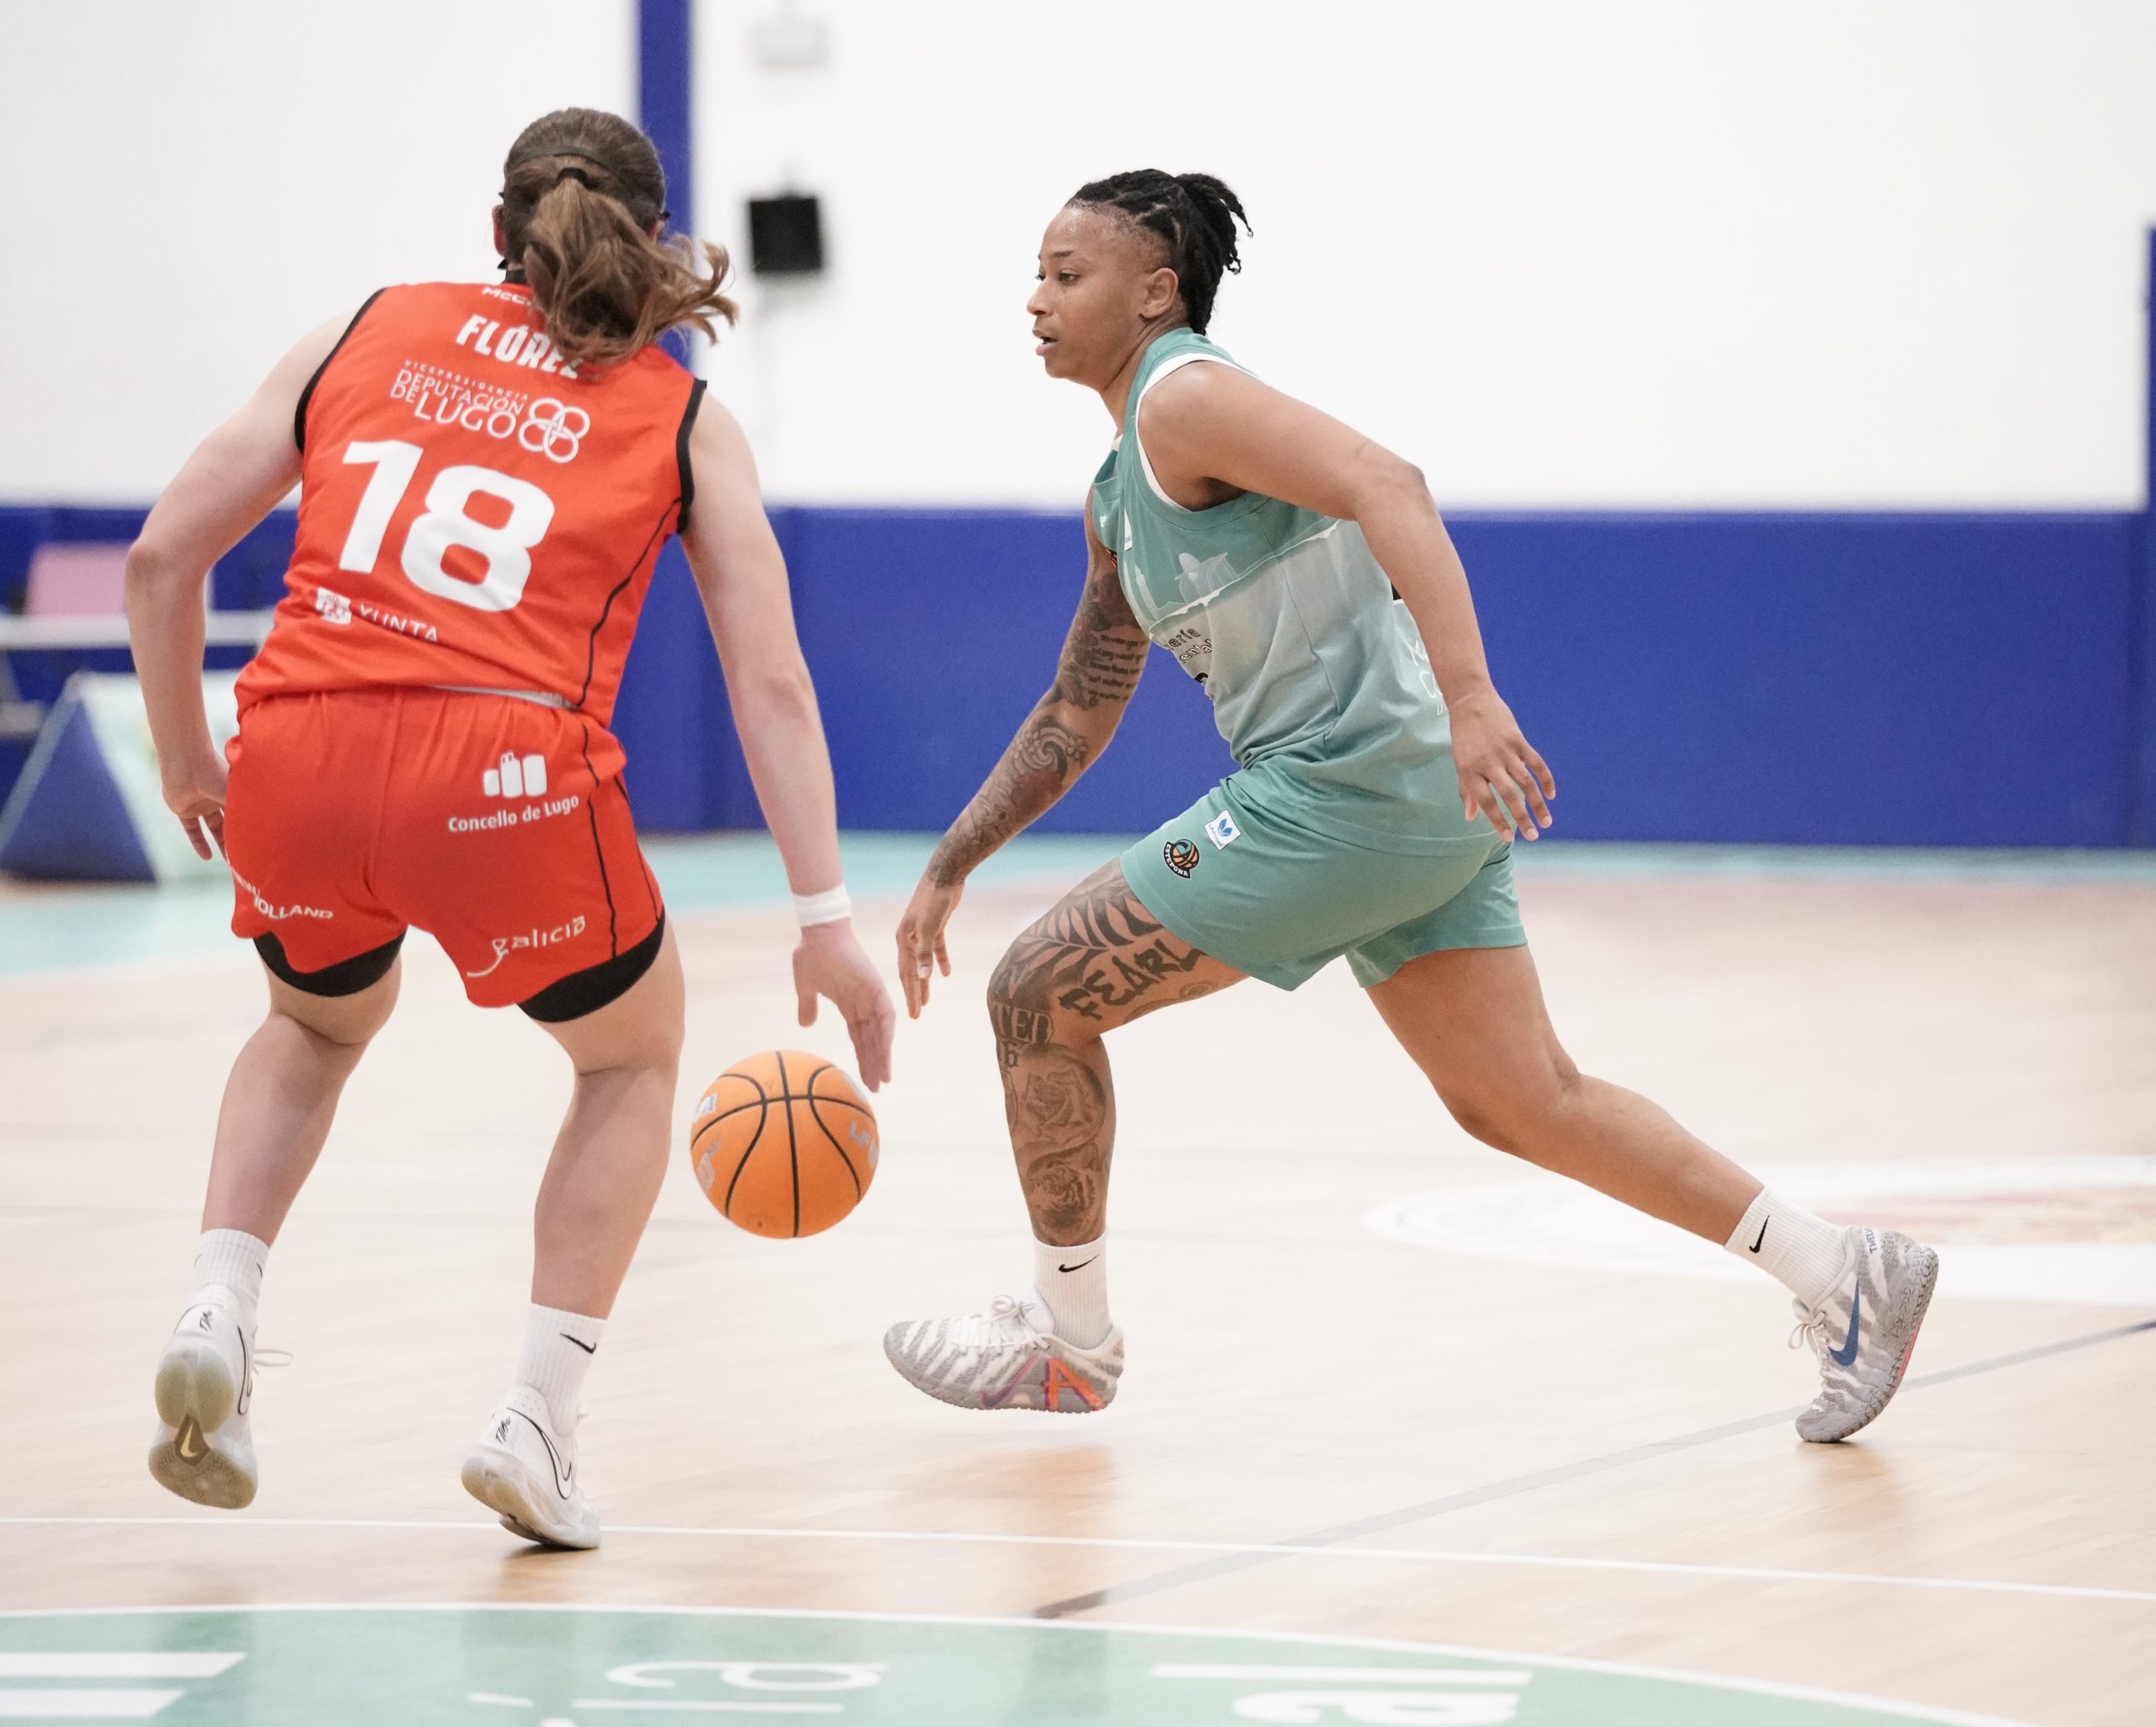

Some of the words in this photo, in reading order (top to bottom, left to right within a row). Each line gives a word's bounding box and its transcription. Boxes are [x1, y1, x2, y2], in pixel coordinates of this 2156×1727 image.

[404, 359, 529, 402] VICEPRESIDENCIA
[391, 381, 420, 403] DE
[414, 391, 517, 439] LUGO
[338, 440, 556, 613] 18
[448, 810, 518, 833] Concello
[522, 805, 541, 823] de
[544, 795, 579, 815] Lugo
[1165, 843, 1189, 877] ESTEPONA
[1058, 938, 1210, 1021] FEARL
